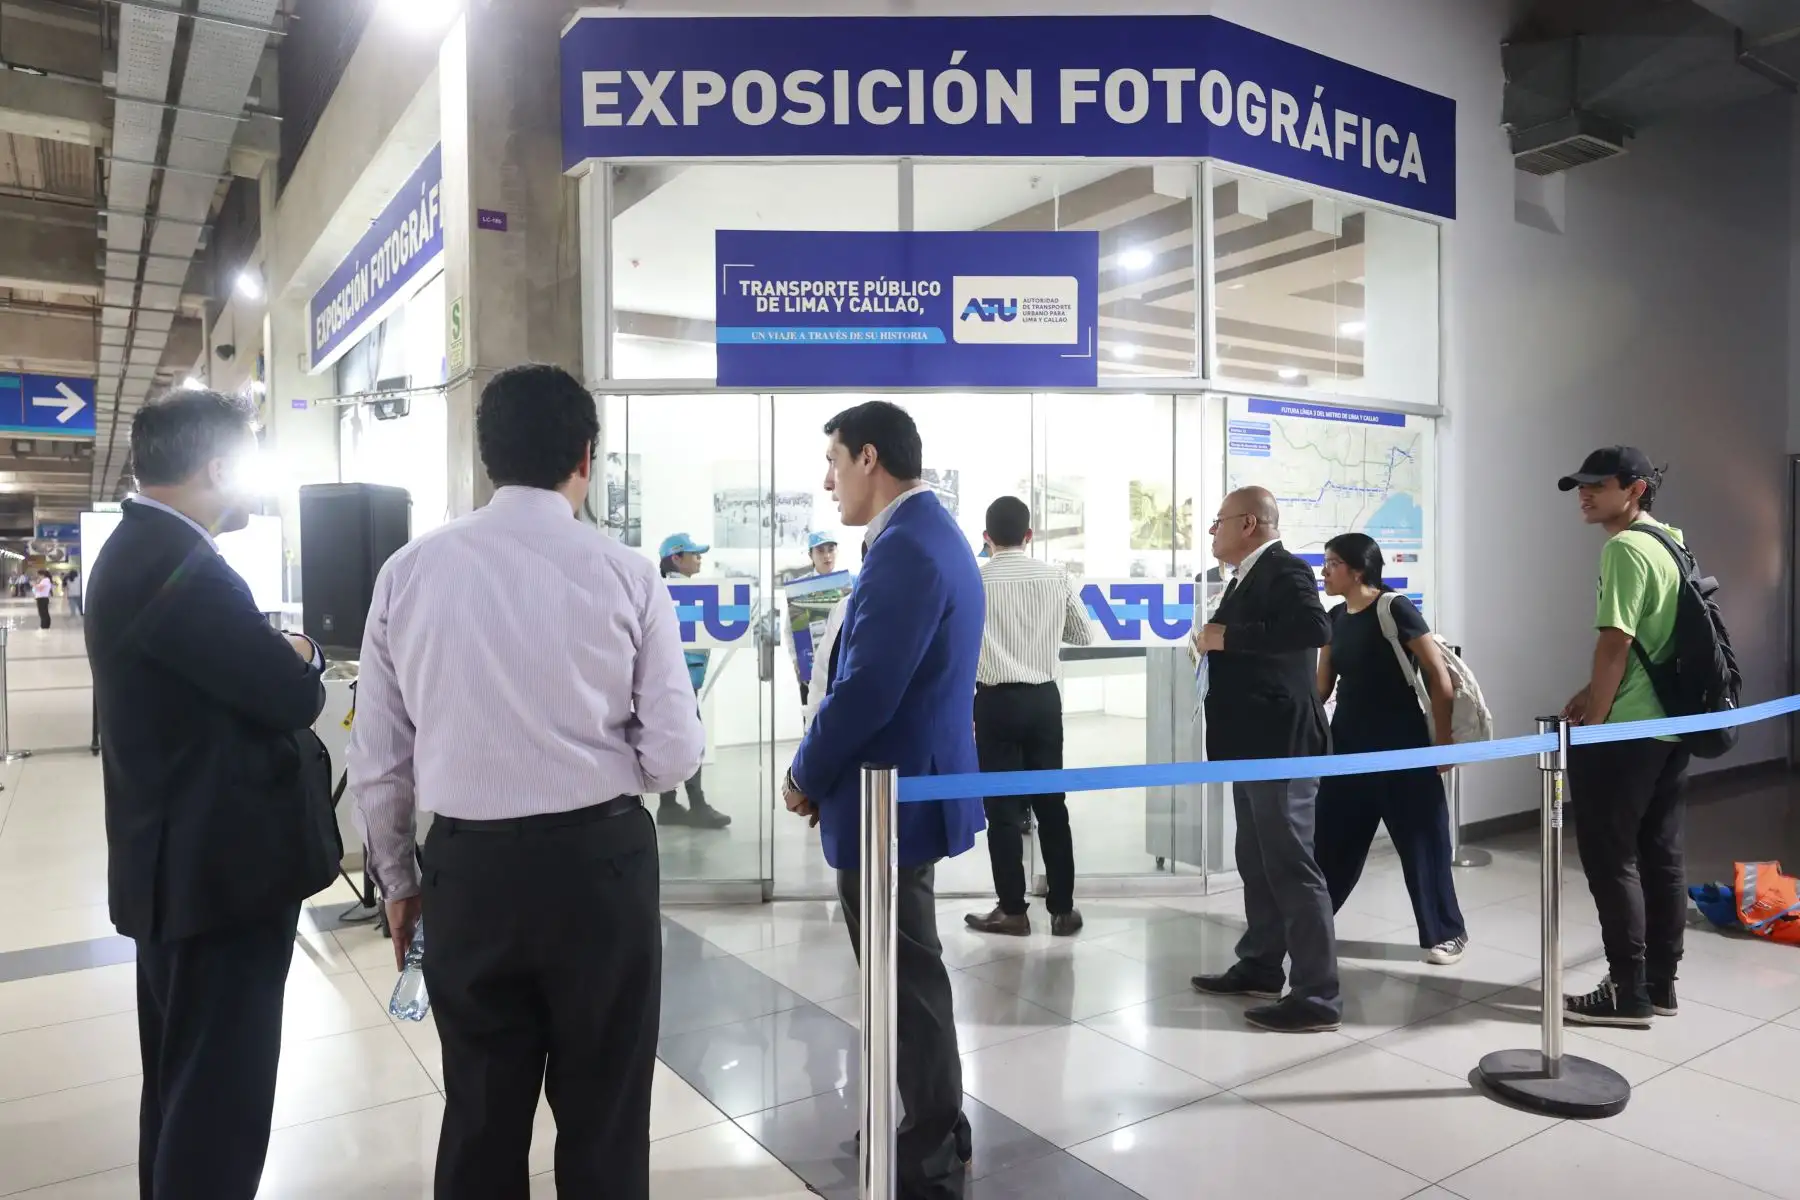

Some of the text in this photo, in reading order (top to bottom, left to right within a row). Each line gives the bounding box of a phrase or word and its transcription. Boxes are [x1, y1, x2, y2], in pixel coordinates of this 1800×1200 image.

[582, 50, 1427, 184] EXPOSICIÓN FOTOGRÁFICA
[739, 276, 941, 297] TRANSPORTE PÚBLICO
[316, 260, 368, 350] EXPOSICIÓN
[756, 297, 924, 315] DE LIMA Y CALLAO,
[960, 298, 1017, 322] ATU
[452, 303, 460, 339] S
[751, 330, 928, 340] UN VIAJE A TRAVÉS DE SU HISTORIA
[1281, 406, 1300, 414] FUTURA
[1316, 410, 1325, 418] DEL
[1325, 411, 1341, 419] METRO
[1341, 412, 1348, 420] DE
[1348, 413, 1359, 421] LIMA
[667, 584, 750, 642] TU
